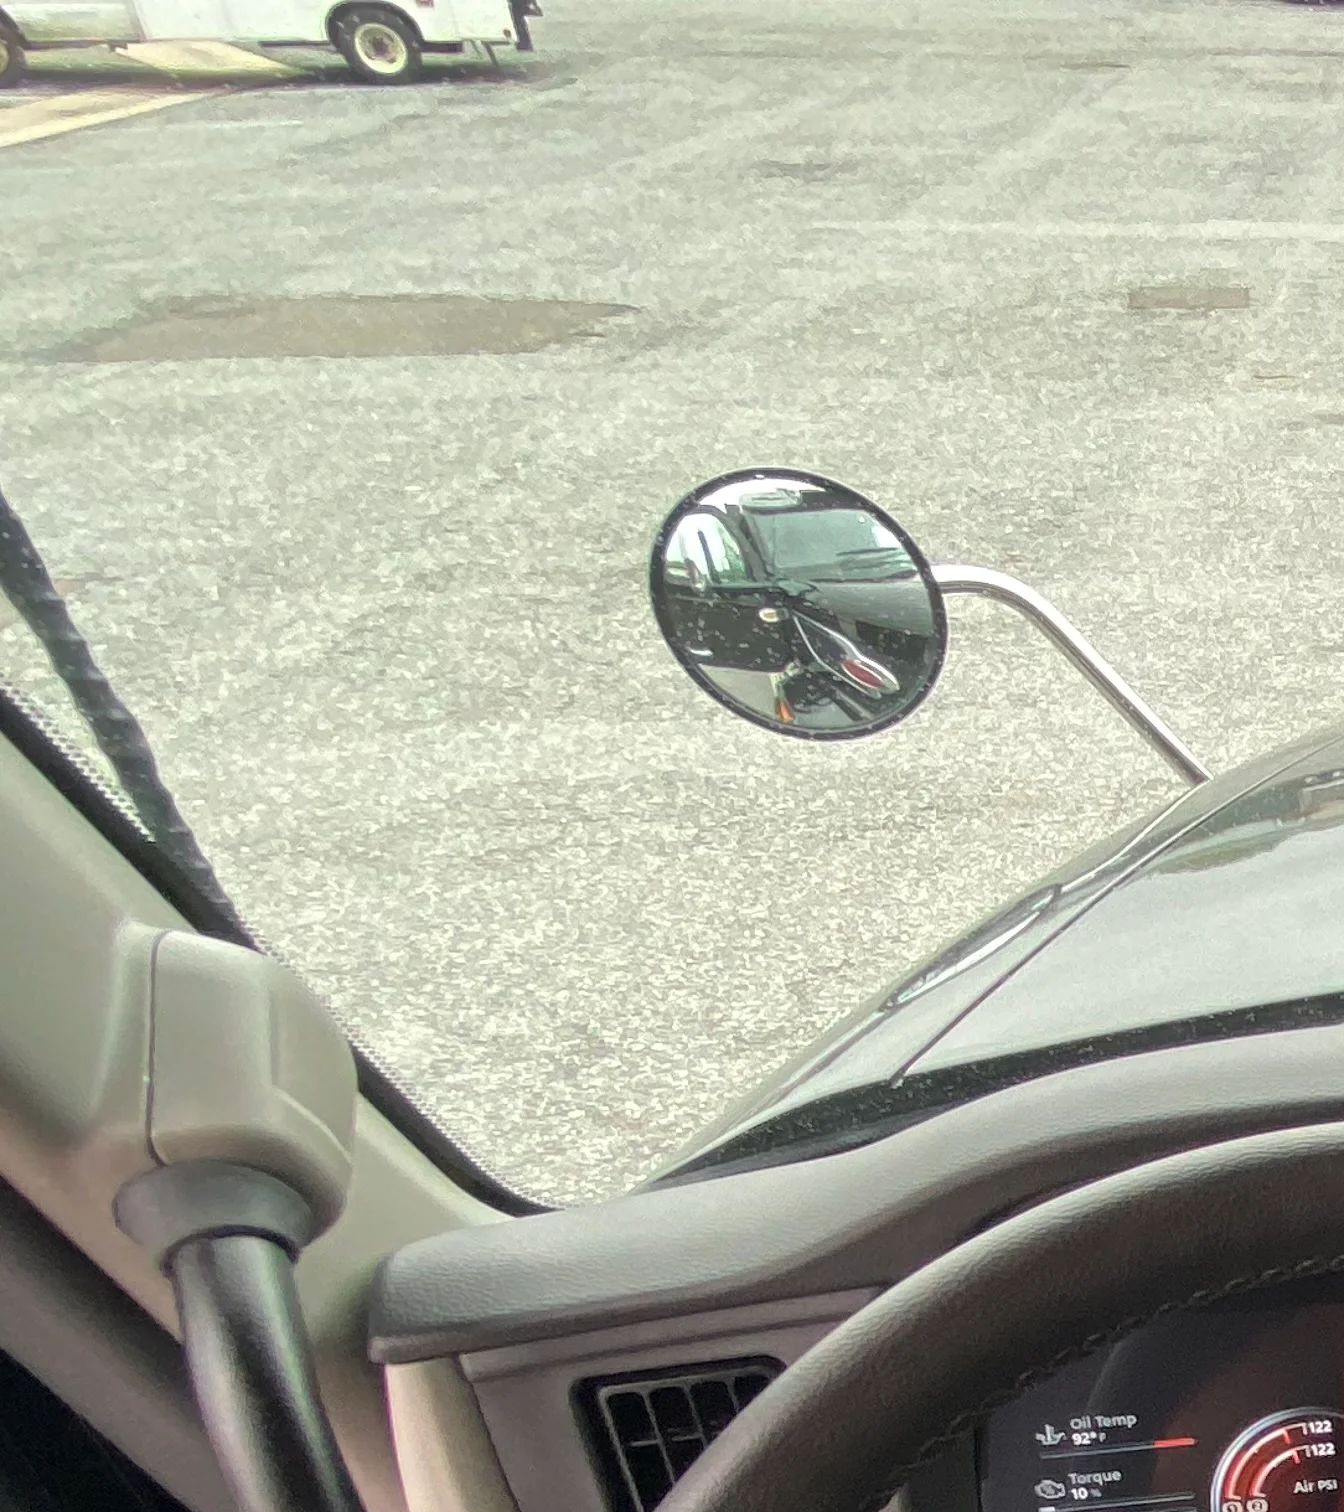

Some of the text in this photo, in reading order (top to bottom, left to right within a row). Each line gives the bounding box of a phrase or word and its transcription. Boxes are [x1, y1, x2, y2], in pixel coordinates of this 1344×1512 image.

[1070, 1413, 1138, 1430] Oil Temp
[1309, 1420, 1333, 1434] 122
[1312, 1443, 1336, 1457] 122
[1068, 1470, 1122, 1488] Torque
[1071, 1487, 1088, 1500] 10
[1293, 1479, 1338, 1494] Air PSI
